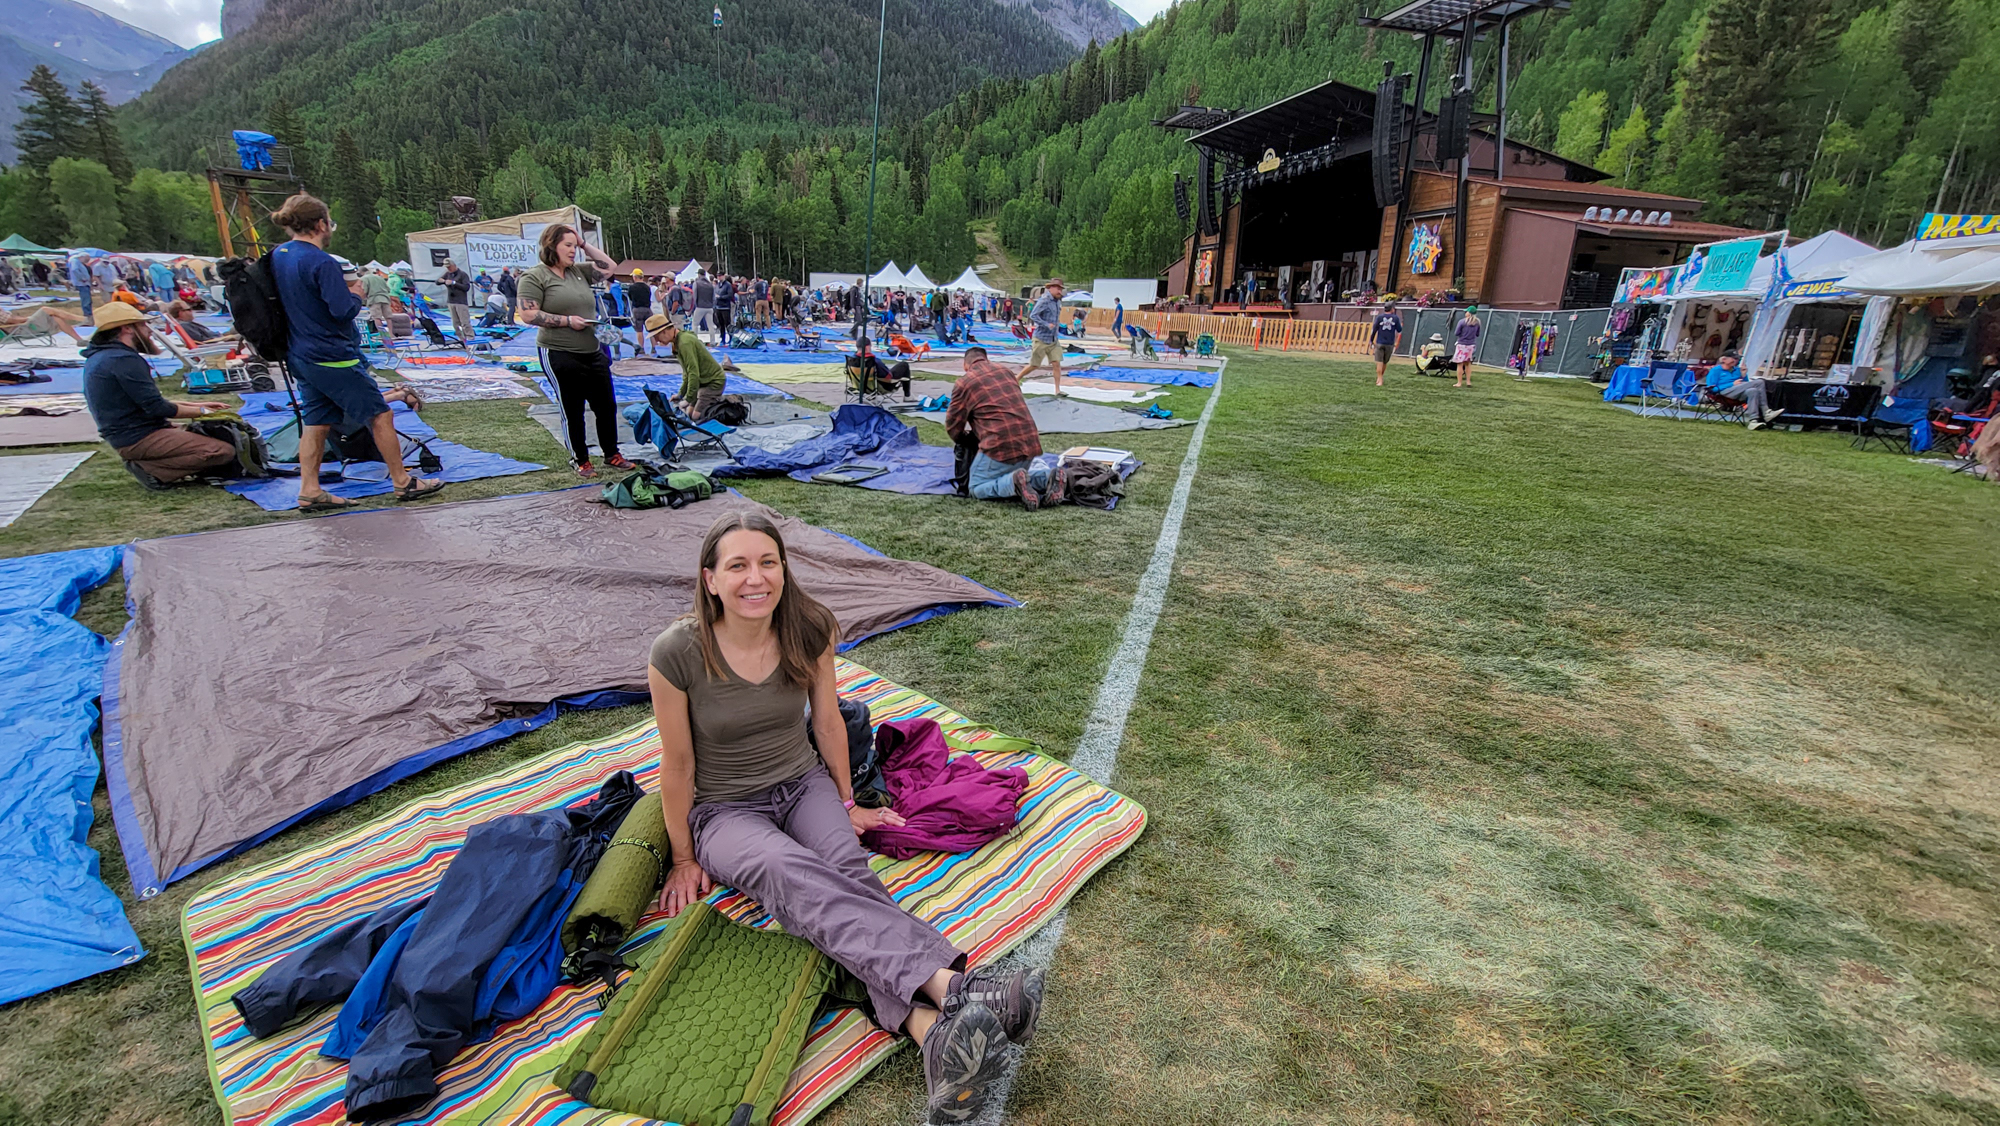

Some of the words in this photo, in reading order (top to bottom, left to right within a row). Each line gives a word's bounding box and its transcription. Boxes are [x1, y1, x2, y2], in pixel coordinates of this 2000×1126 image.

[1920, 214, 2000, 239] MAS
[468, 242, 537, 254] MOUNTAIN
[485, 251, 527, 261] LODGE
[1786, 280, 1847, 296] JEWEL
